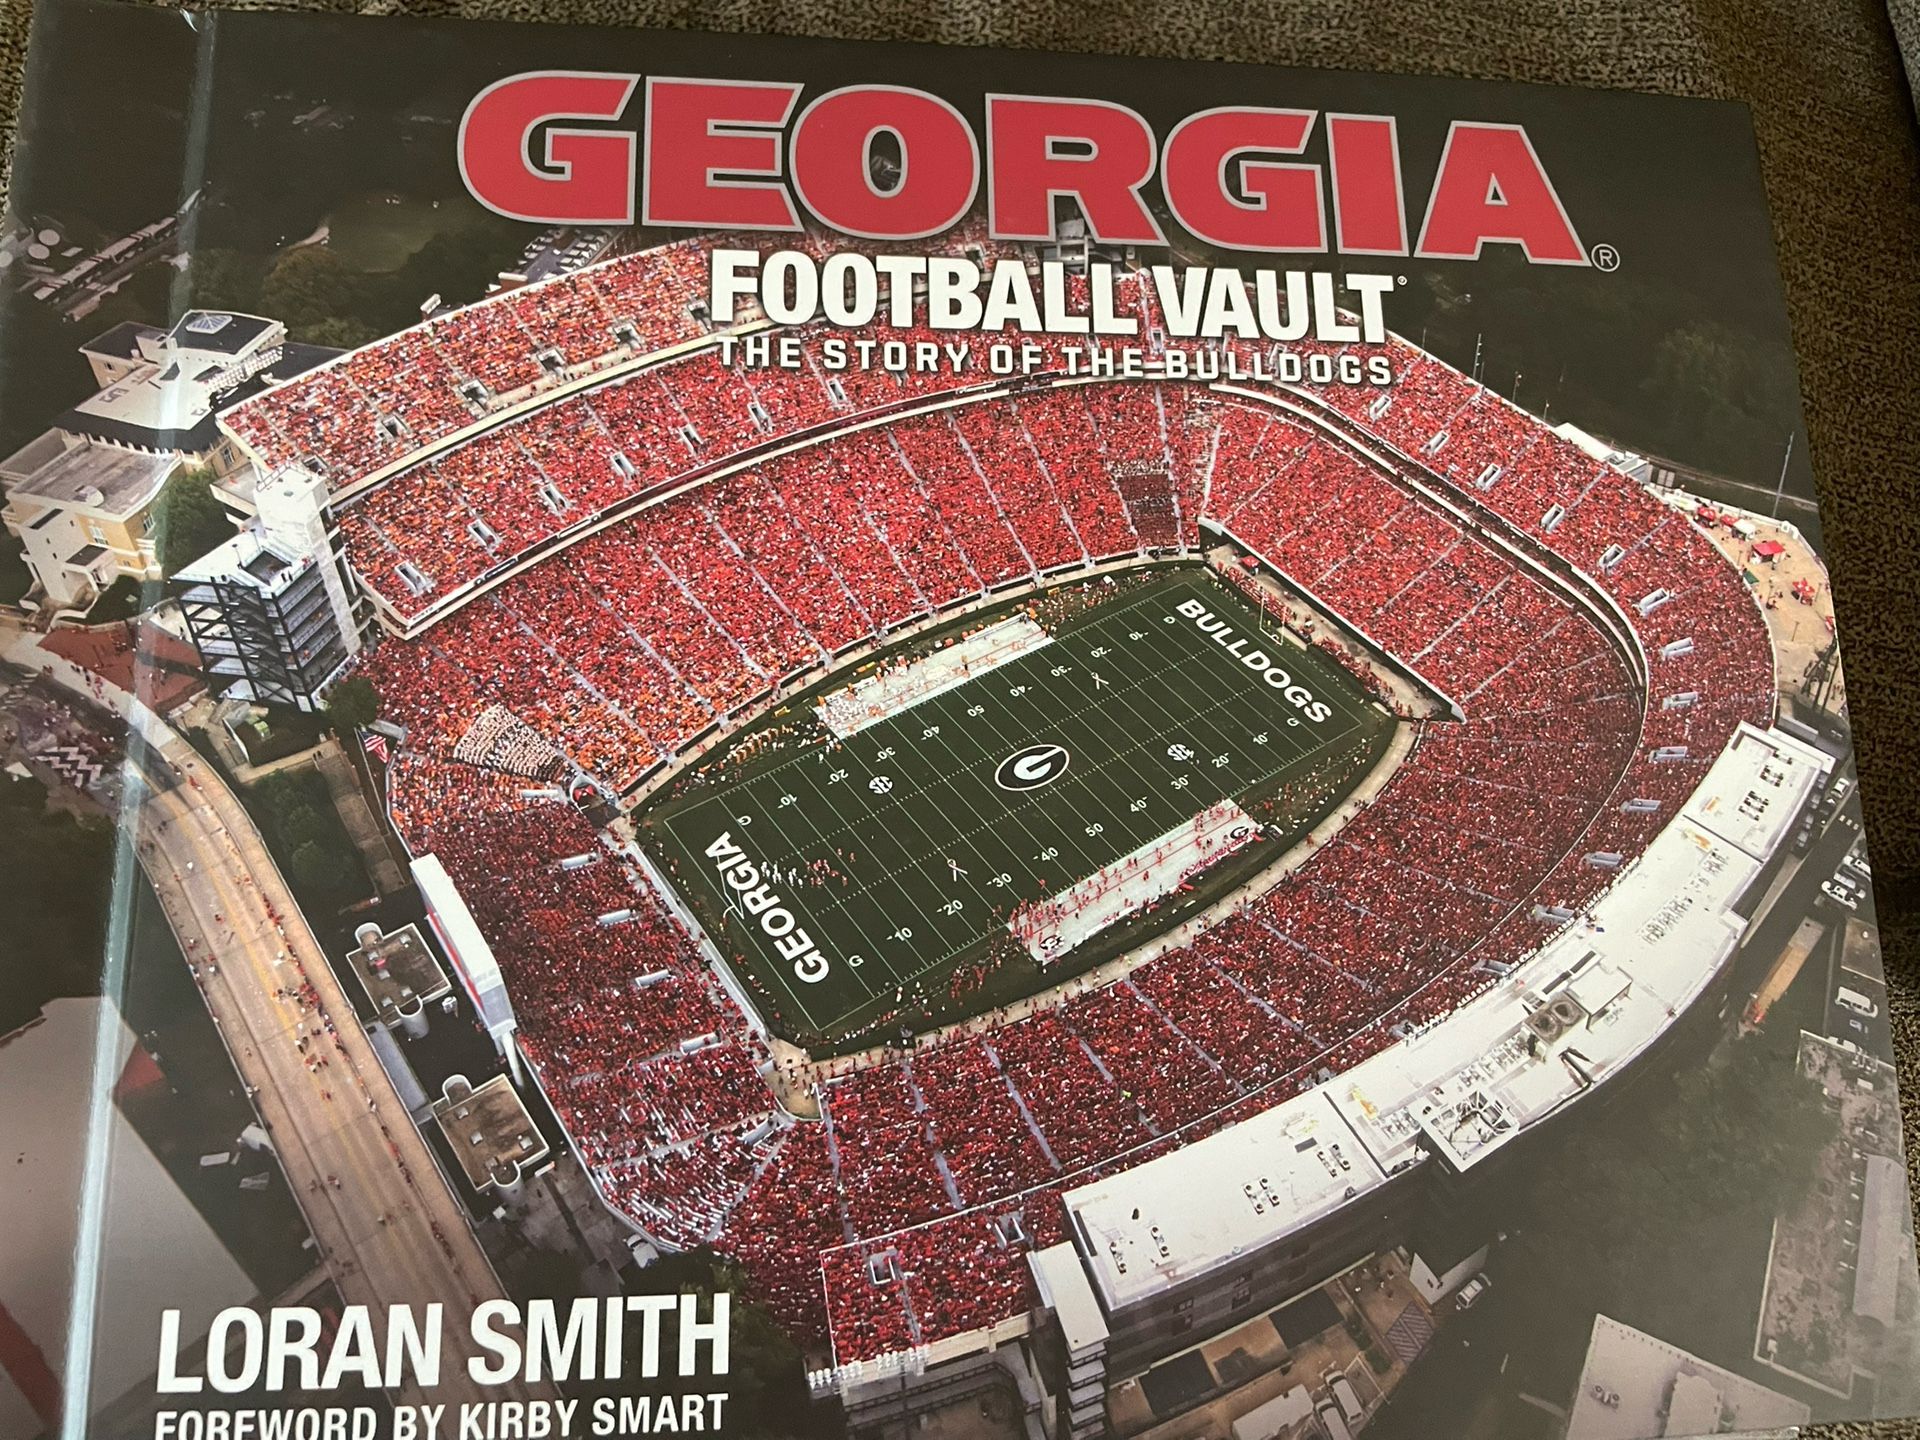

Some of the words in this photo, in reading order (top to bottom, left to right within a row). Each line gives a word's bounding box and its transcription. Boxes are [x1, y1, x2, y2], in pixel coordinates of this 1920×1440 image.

[457, 70, 1592, 267] GEORGIA
[710, 248, 1139, 336] FOOTBALL
[1152, 265, 1395, 343] VAULT
[717, 335, 800, 369] THE
[823, 338, 969, 374] STORY
[989, 343, 1041, 375] OF
[1061, 346, 1144, 378] THE
[1166, 349, 1392, 385] BULLDOGS
[1091, 646, 1108, 659] 20
[1175, 599, 1332, 723] BULLDOGS
[1050, 665, 1069, 678] 30
[1009, 684, 1027, 698] 40
[967, 704, 985, 718] 50
[923, 725, 941, 739] 40
[1253, 732, 1269, 745] 10
[877, 746, 896, 761] 30
[1211, 754, 1230, 768] 20
[829, 768, 849, 783] 20
[869, 776, 893, 794] SEC
[1171, 777, 1189, 790] 30
[1130, 799, 1148, 813] 40
[1085, 822, 1104, 837] 50
[1041, 847, 1059, 862] 40
[992, 872, 1012, 888] 30
[705, 831, 830, 984] GEORGIA
[942, 899, 964, 916] 20
[894, 926, 913, 941] 10
[155, 1302, 444, 1394] LORAN
[467, 1292, 731, 1386] SMITH
[155, 1406, 378, 1440] FOREWORD
[393, 1404, 446, 1440] BY
[459, 1398, 579, 1440] KIRBY
[592, 1392, 729, 1436] SMART
